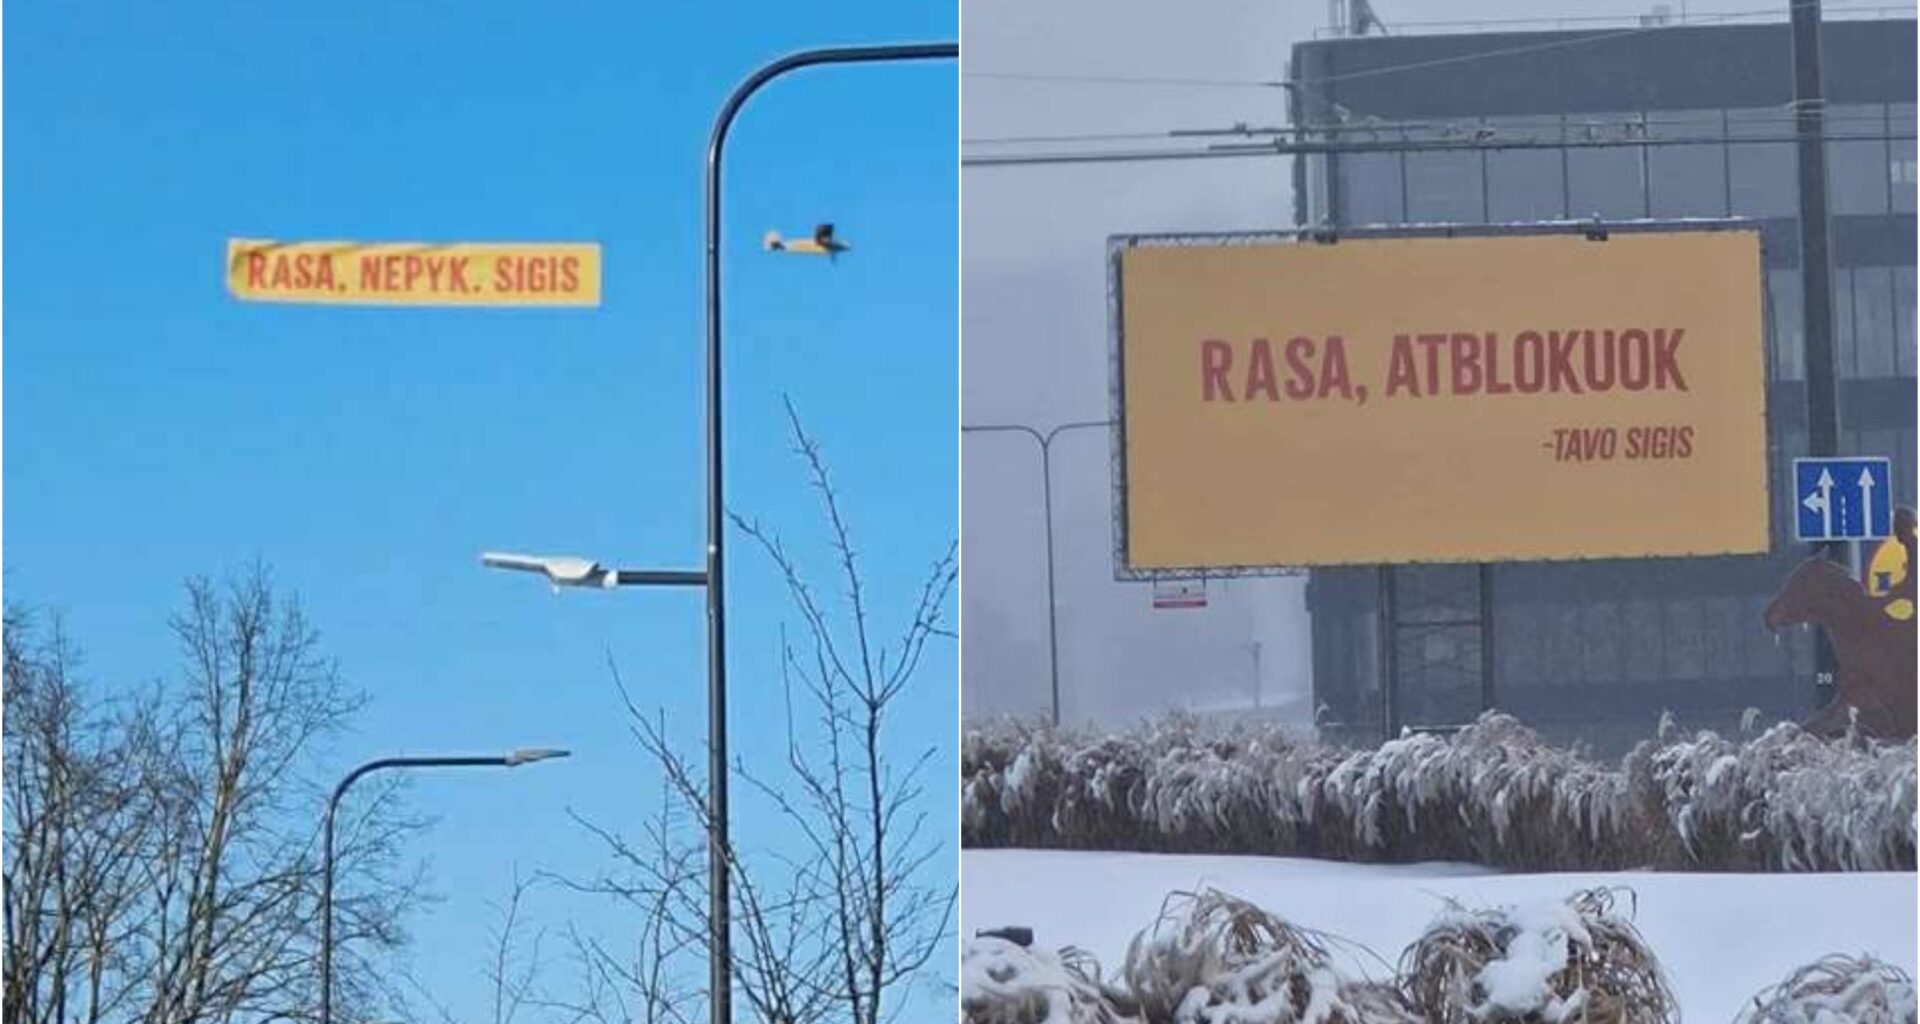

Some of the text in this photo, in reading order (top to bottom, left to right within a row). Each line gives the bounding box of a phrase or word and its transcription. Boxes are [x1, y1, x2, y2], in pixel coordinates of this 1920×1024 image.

[360, 255, 482, 294] NEPYK.
[494, 256, 580, 293] SIGIS
[1201, 328, 1689, 405] RASA, ATBLOKUOK
[1542, 425, 1694, 463] -TAVO SIGIS
